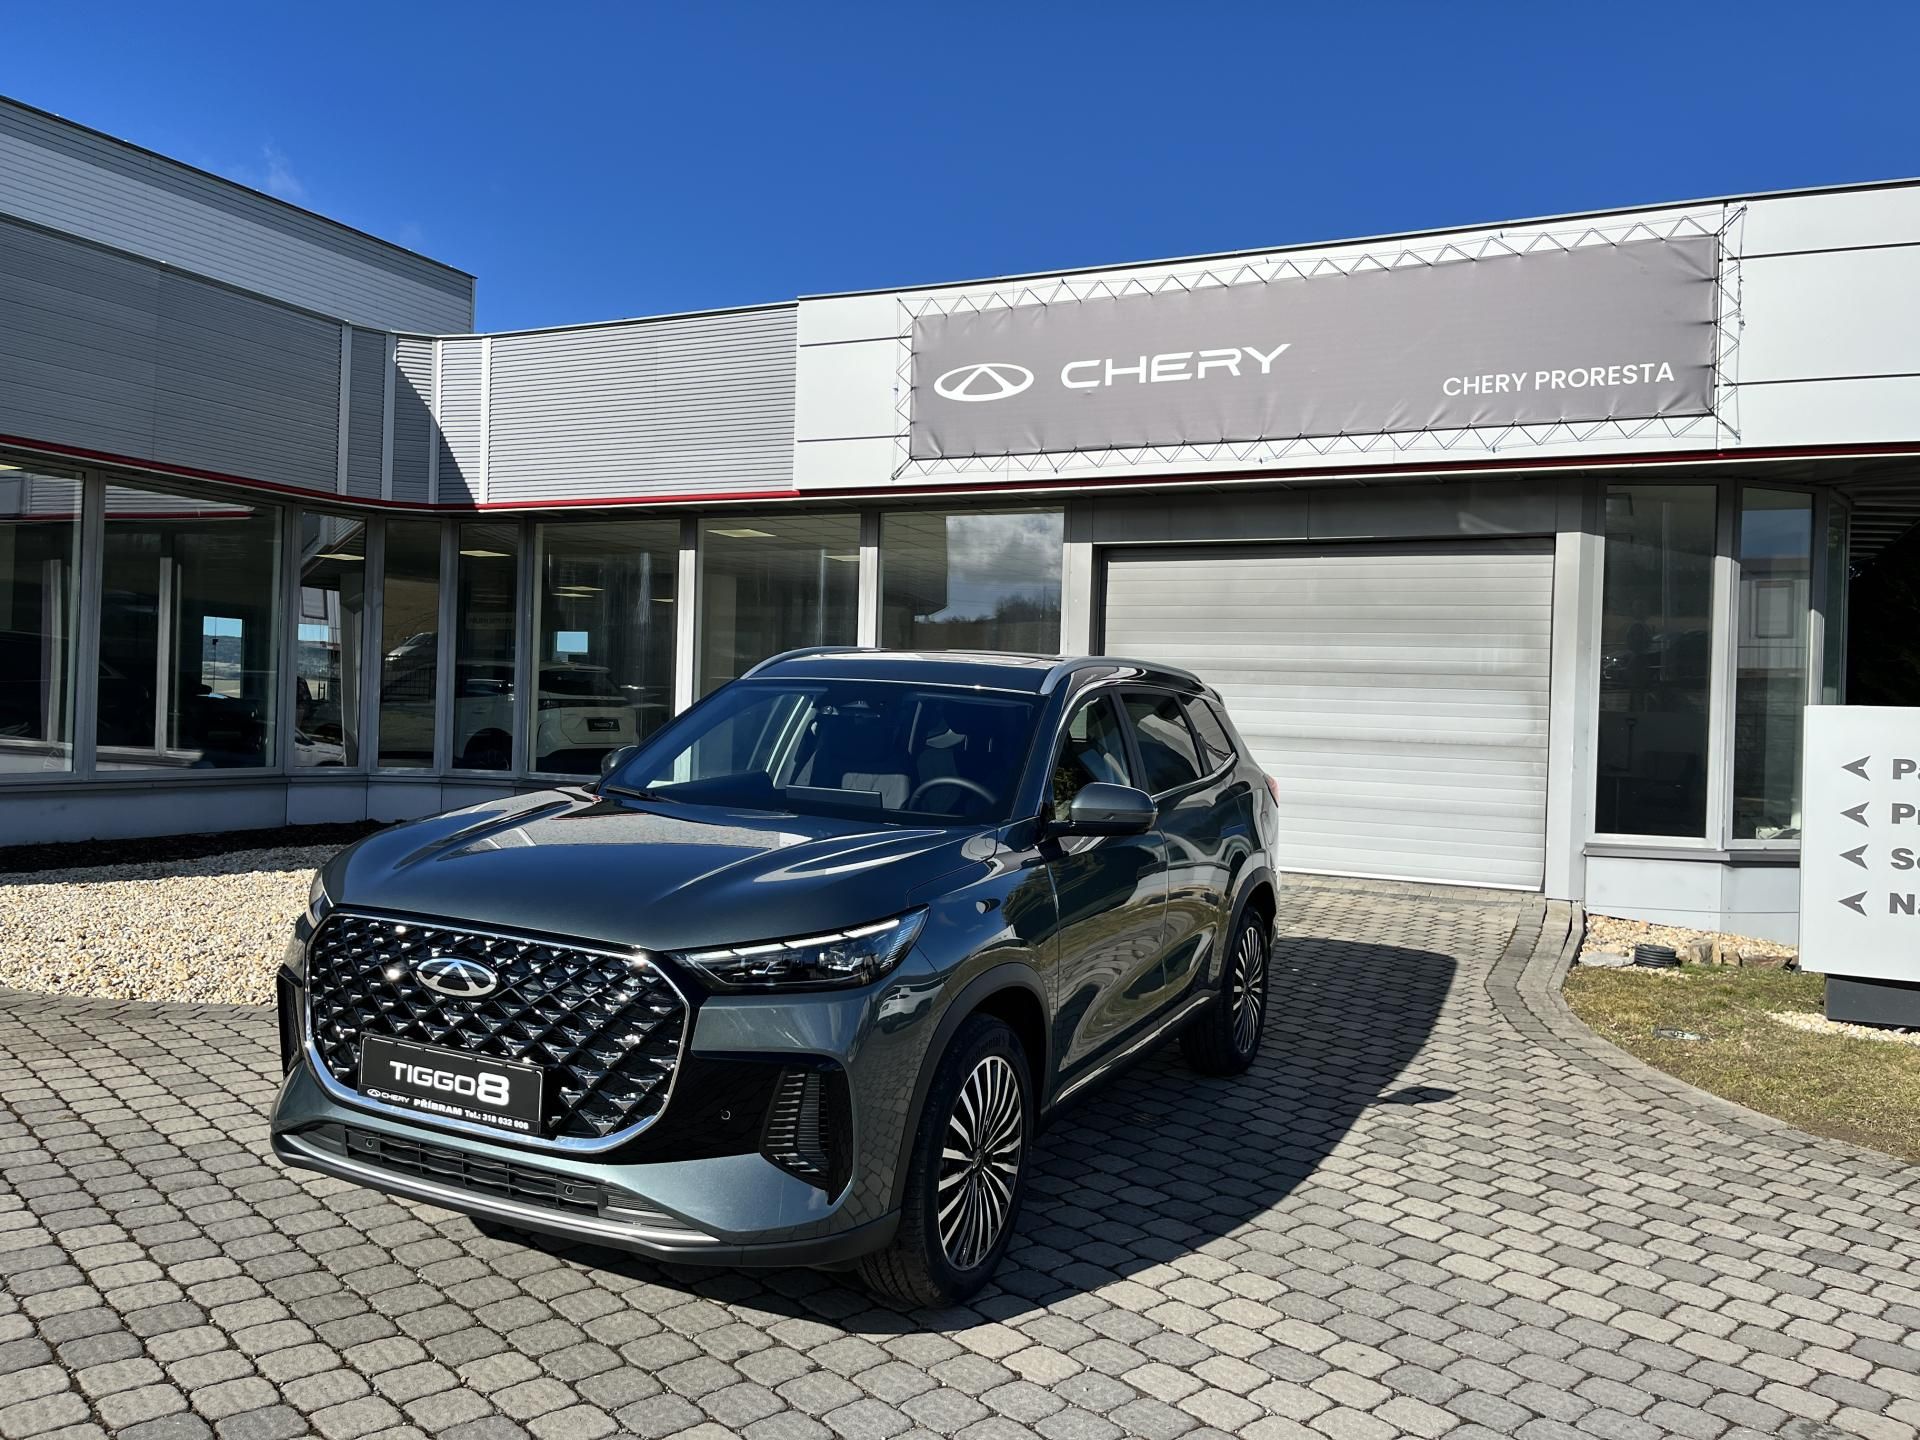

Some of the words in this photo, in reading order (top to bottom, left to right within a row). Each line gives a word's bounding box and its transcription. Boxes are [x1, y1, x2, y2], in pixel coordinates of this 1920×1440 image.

[1060, 343, 1292, 390] CHERY
[1442, 372, 1528, 397] CHERY
[1534, 361, 1675, 390] PRORESTA
[1892, 758, 1920, 781] P
[1891, 802, 1920, 826] P
[1890, 847, 1920, 871] S
[1888, 892, 1920, 916] N
[381, 1091, 410, 1104] CHERY
[413, 1098, 463, 1116] PŘÍBRAM
